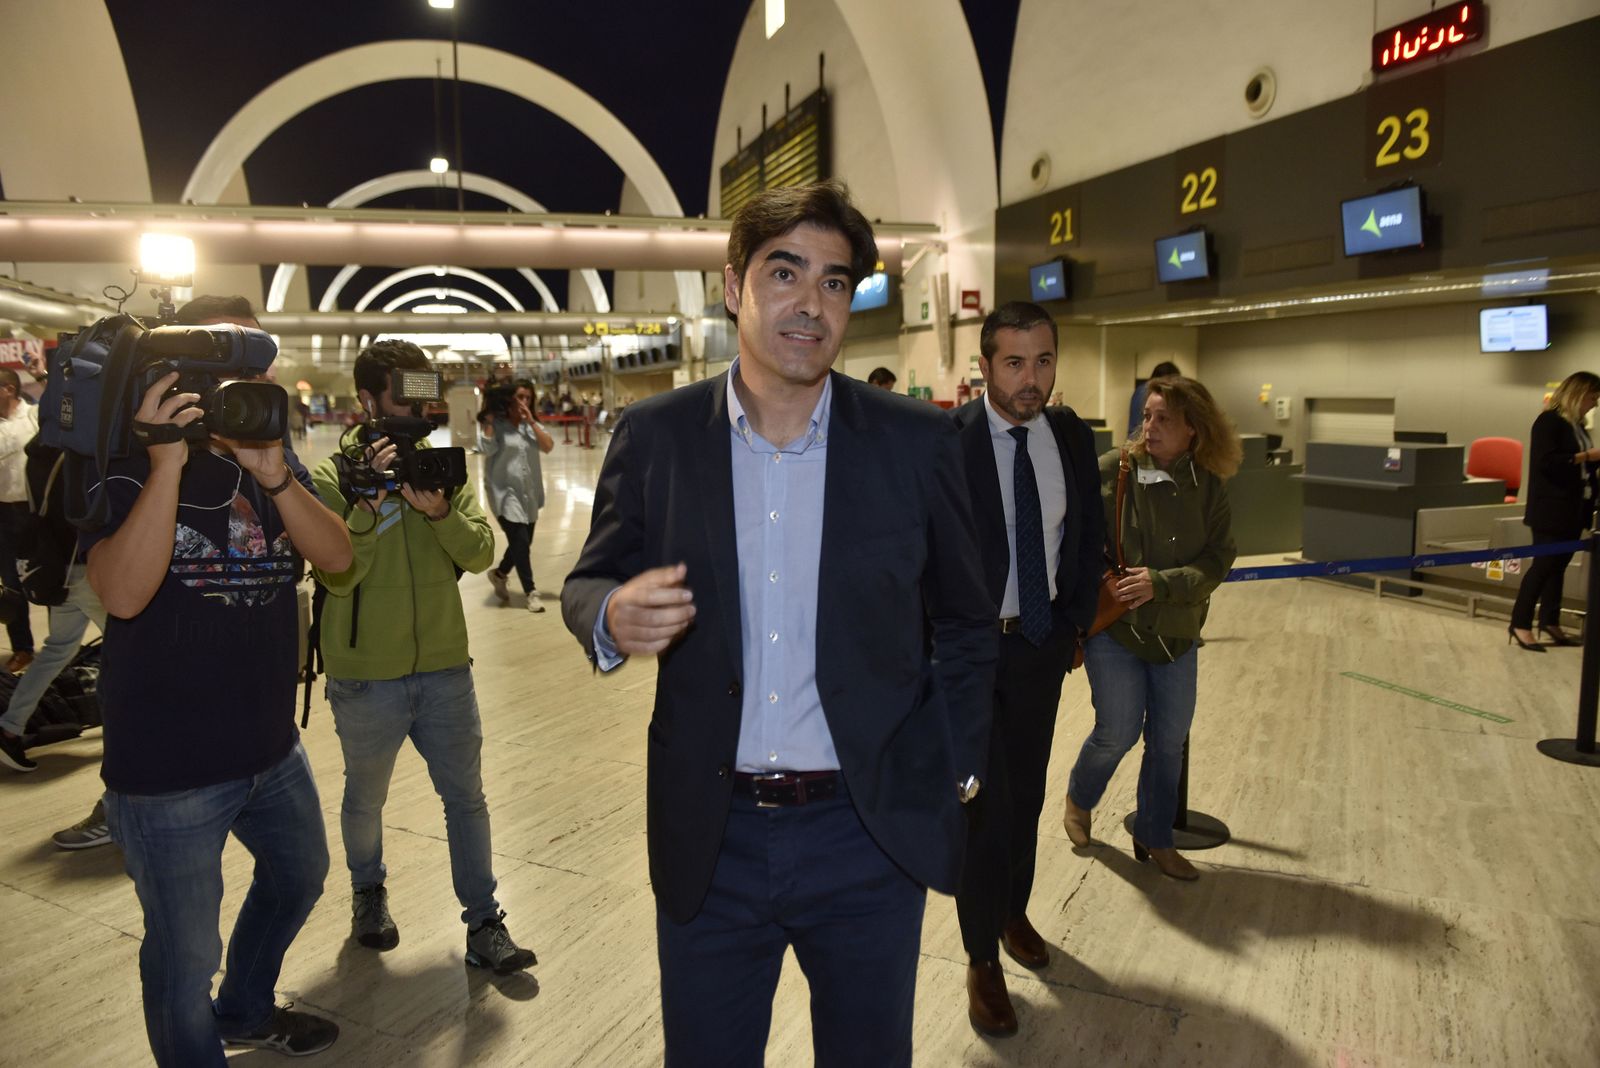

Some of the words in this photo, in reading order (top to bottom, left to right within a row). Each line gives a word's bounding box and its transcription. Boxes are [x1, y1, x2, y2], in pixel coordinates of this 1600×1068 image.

[1375, 108, 1430, 168] 23
[1180, 167, 1218, 215] 22
[1050, 208, 1074, 245] 21
